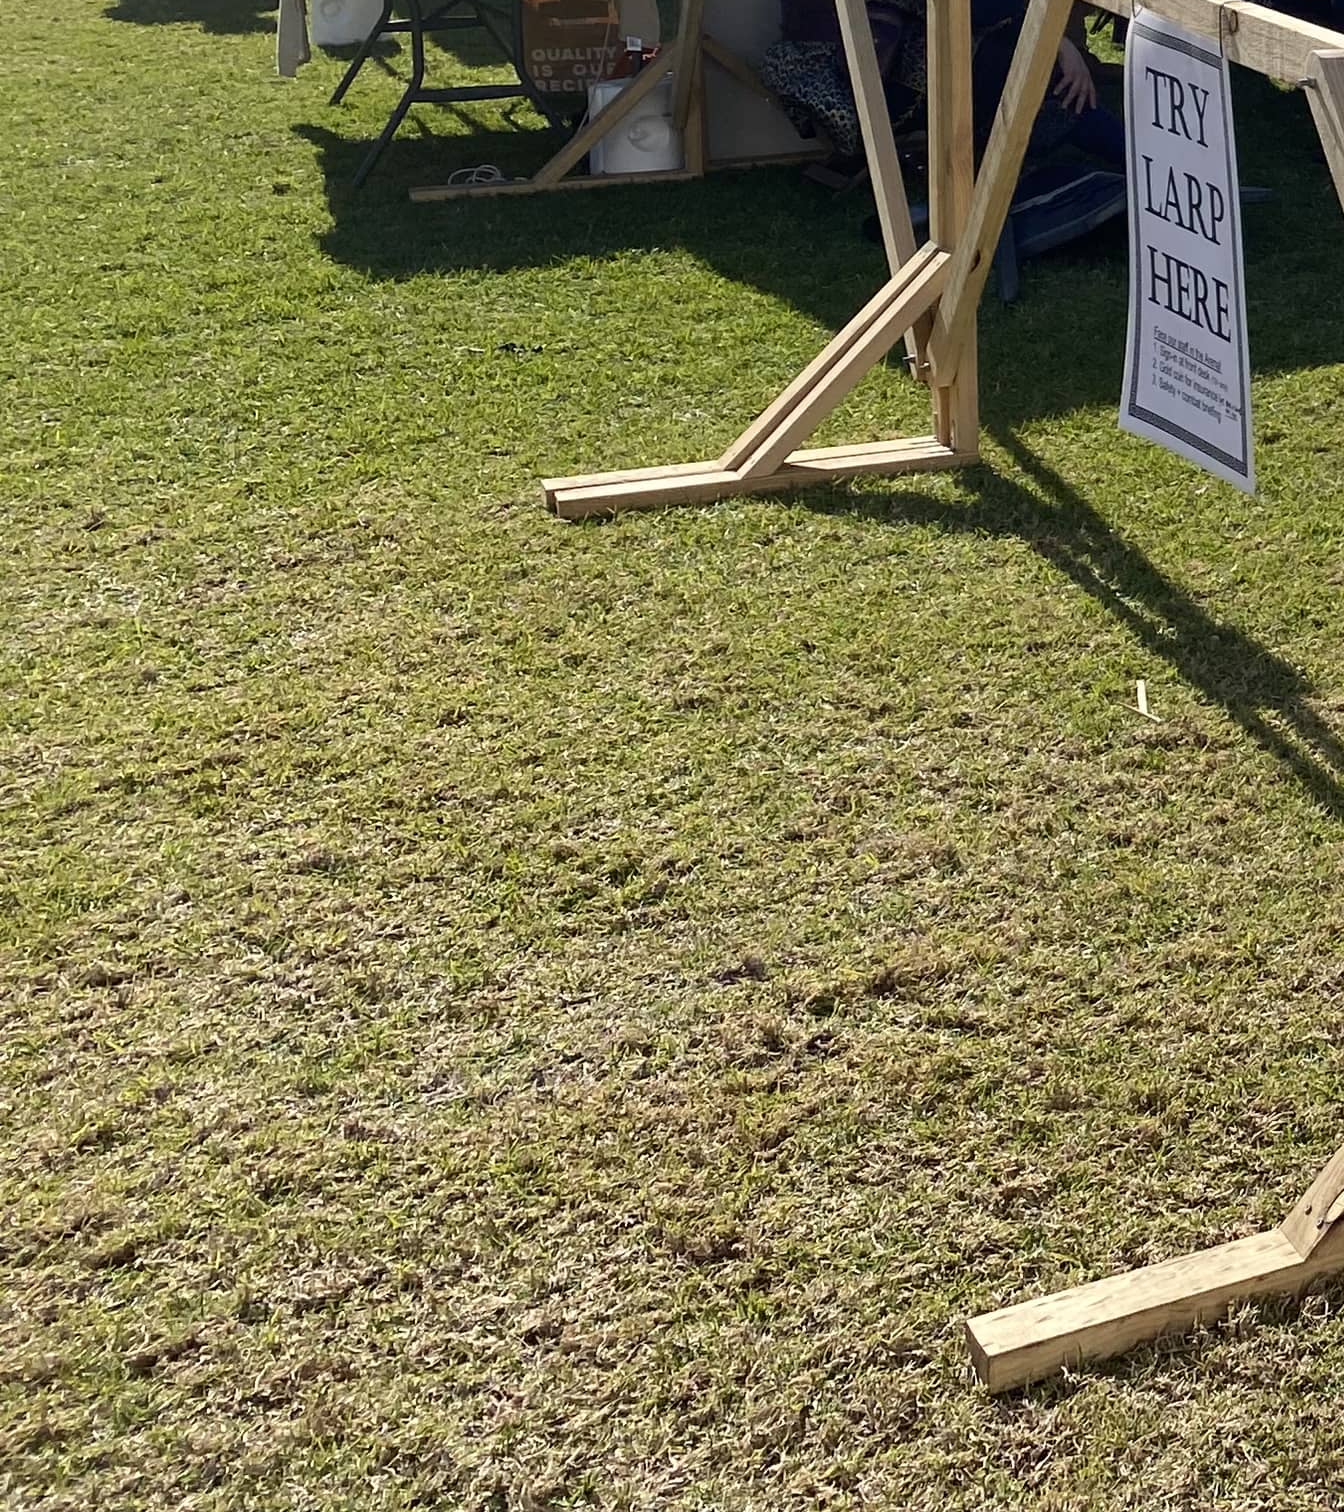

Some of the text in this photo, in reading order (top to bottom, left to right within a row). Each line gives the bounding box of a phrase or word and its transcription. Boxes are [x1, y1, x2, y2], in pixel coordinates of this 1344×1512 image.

[531, 47, 617, 62] QUALITY
[533, 65, 553, 77] IS
[1145, 66, 1210, 148] TRY
[1141, 155, 1225, 246] LARP
[1146, 245, 1231, 343] HERE
